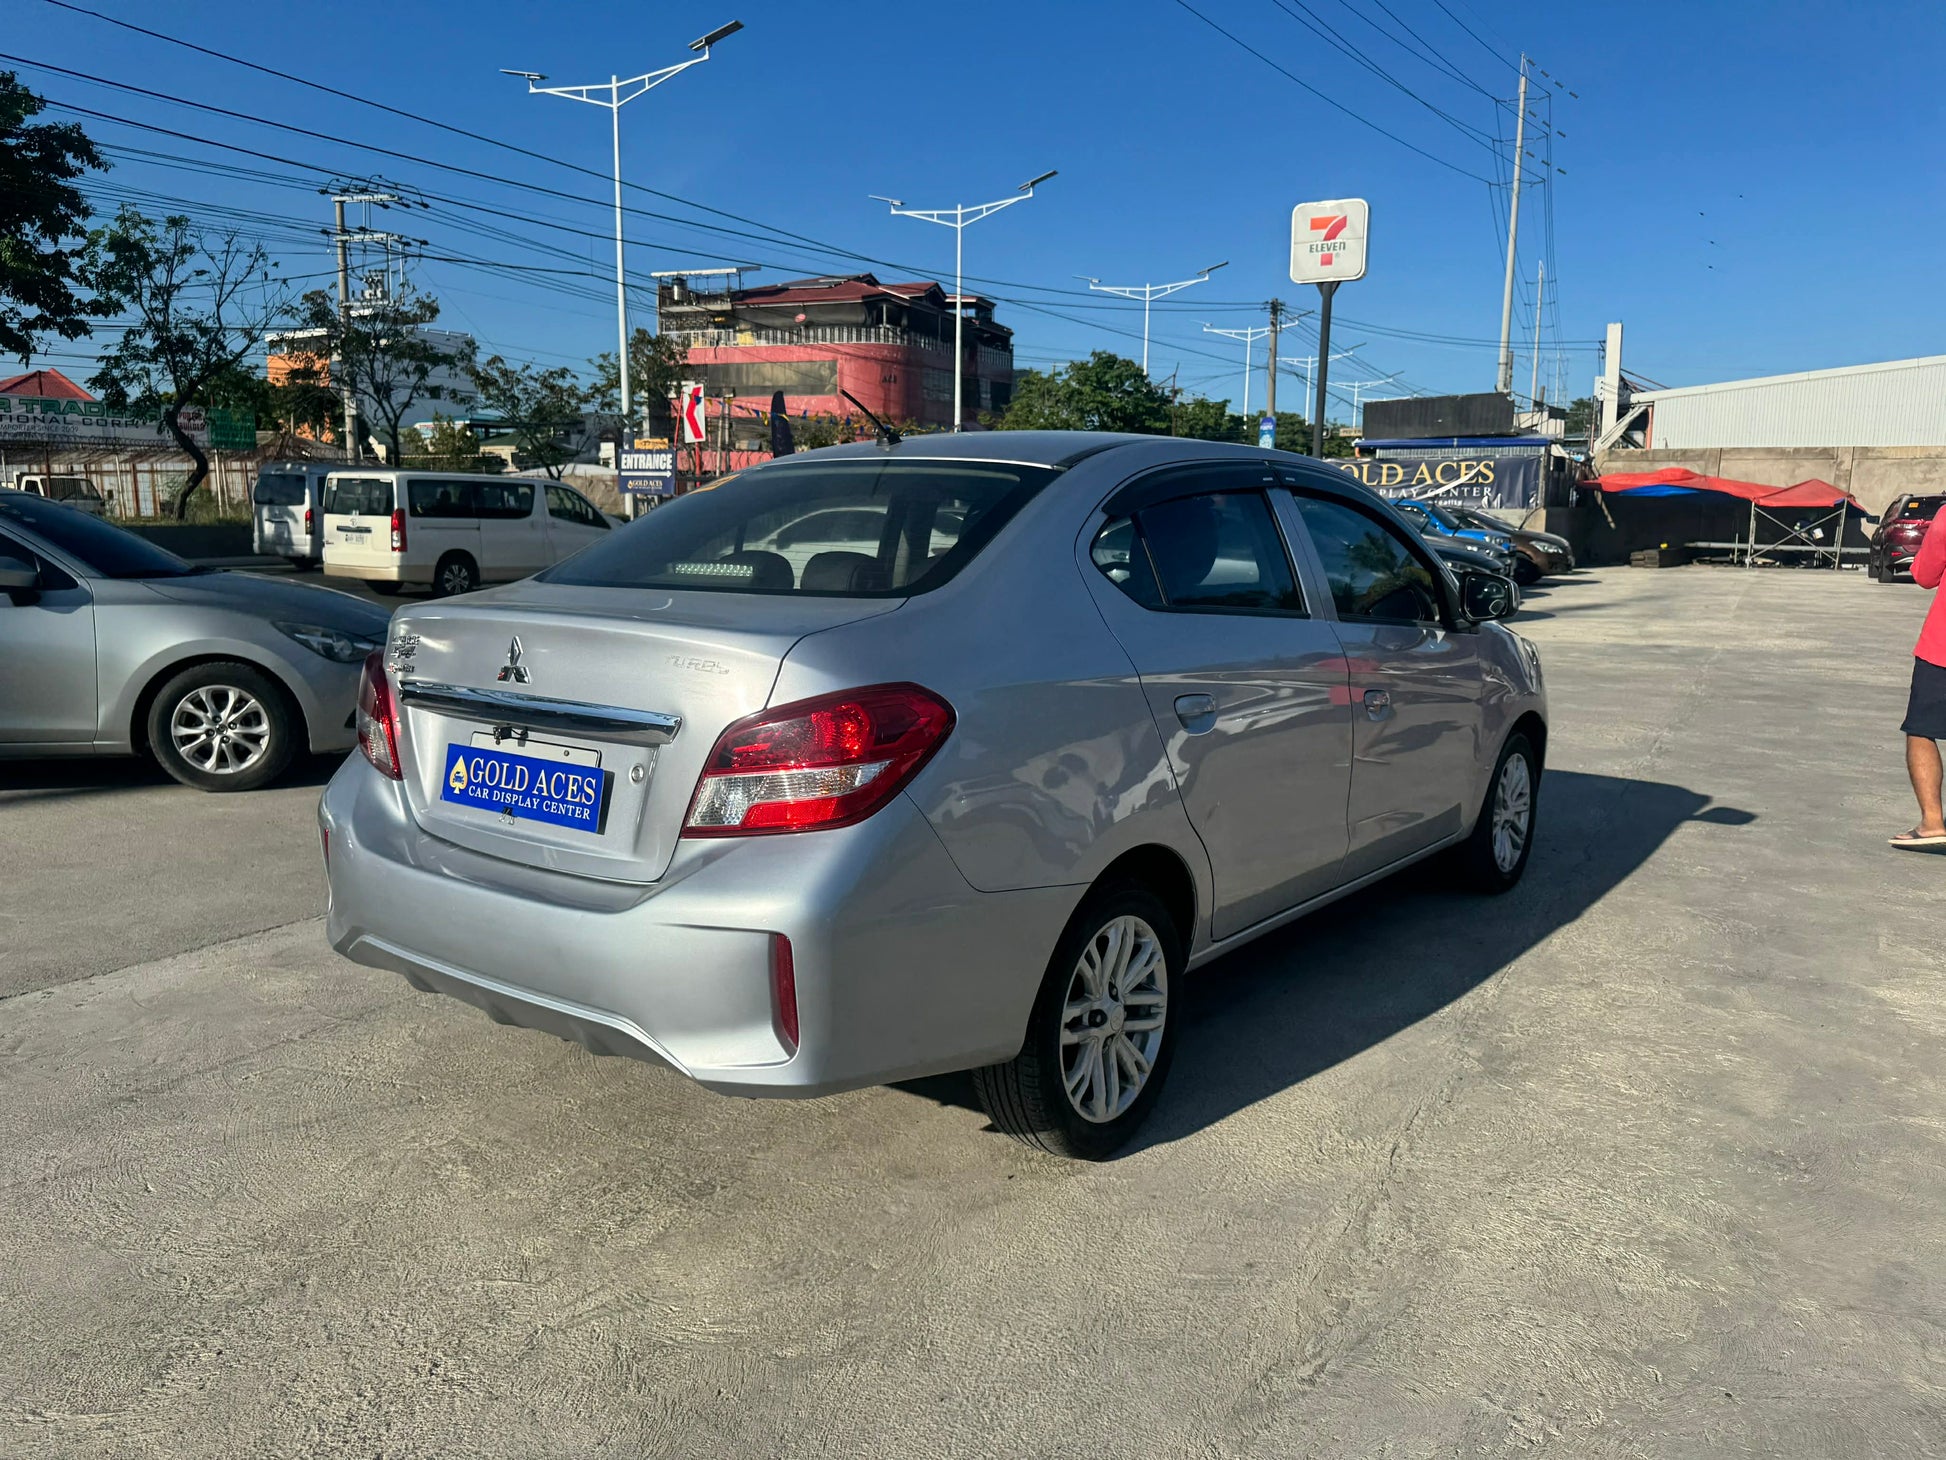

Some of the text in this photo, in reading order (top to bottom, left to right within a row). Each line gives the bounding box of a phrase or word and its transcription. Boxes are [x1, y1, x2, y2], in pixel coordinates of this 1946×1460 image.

[621, 453, 672, 470] ENTRANCE
[1340, 460, 1495, 486] OLD ACES
[470, 757, 596, 805] GOLD ACES
[468, 785, 590, 821] CAR DISPLAY CENTER
